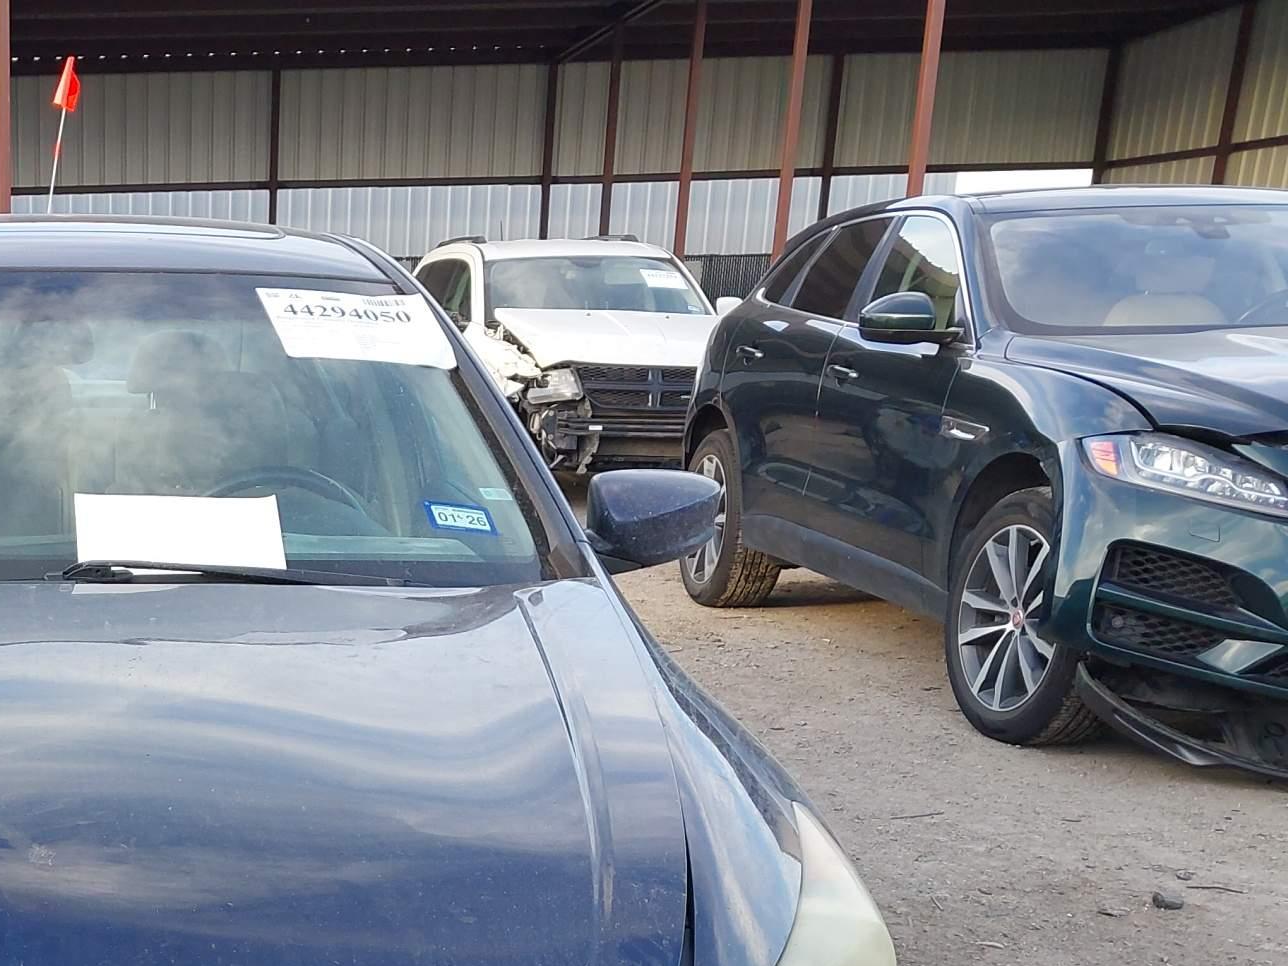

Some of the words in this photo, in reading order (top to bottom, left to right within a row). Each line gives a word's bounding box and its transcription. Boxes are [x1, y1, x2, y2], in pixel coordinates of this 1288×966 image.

[283, 303, 411, 323] 44294050
[437, 511, 457, 523] 01
[466, 514, 487, 527] 26
